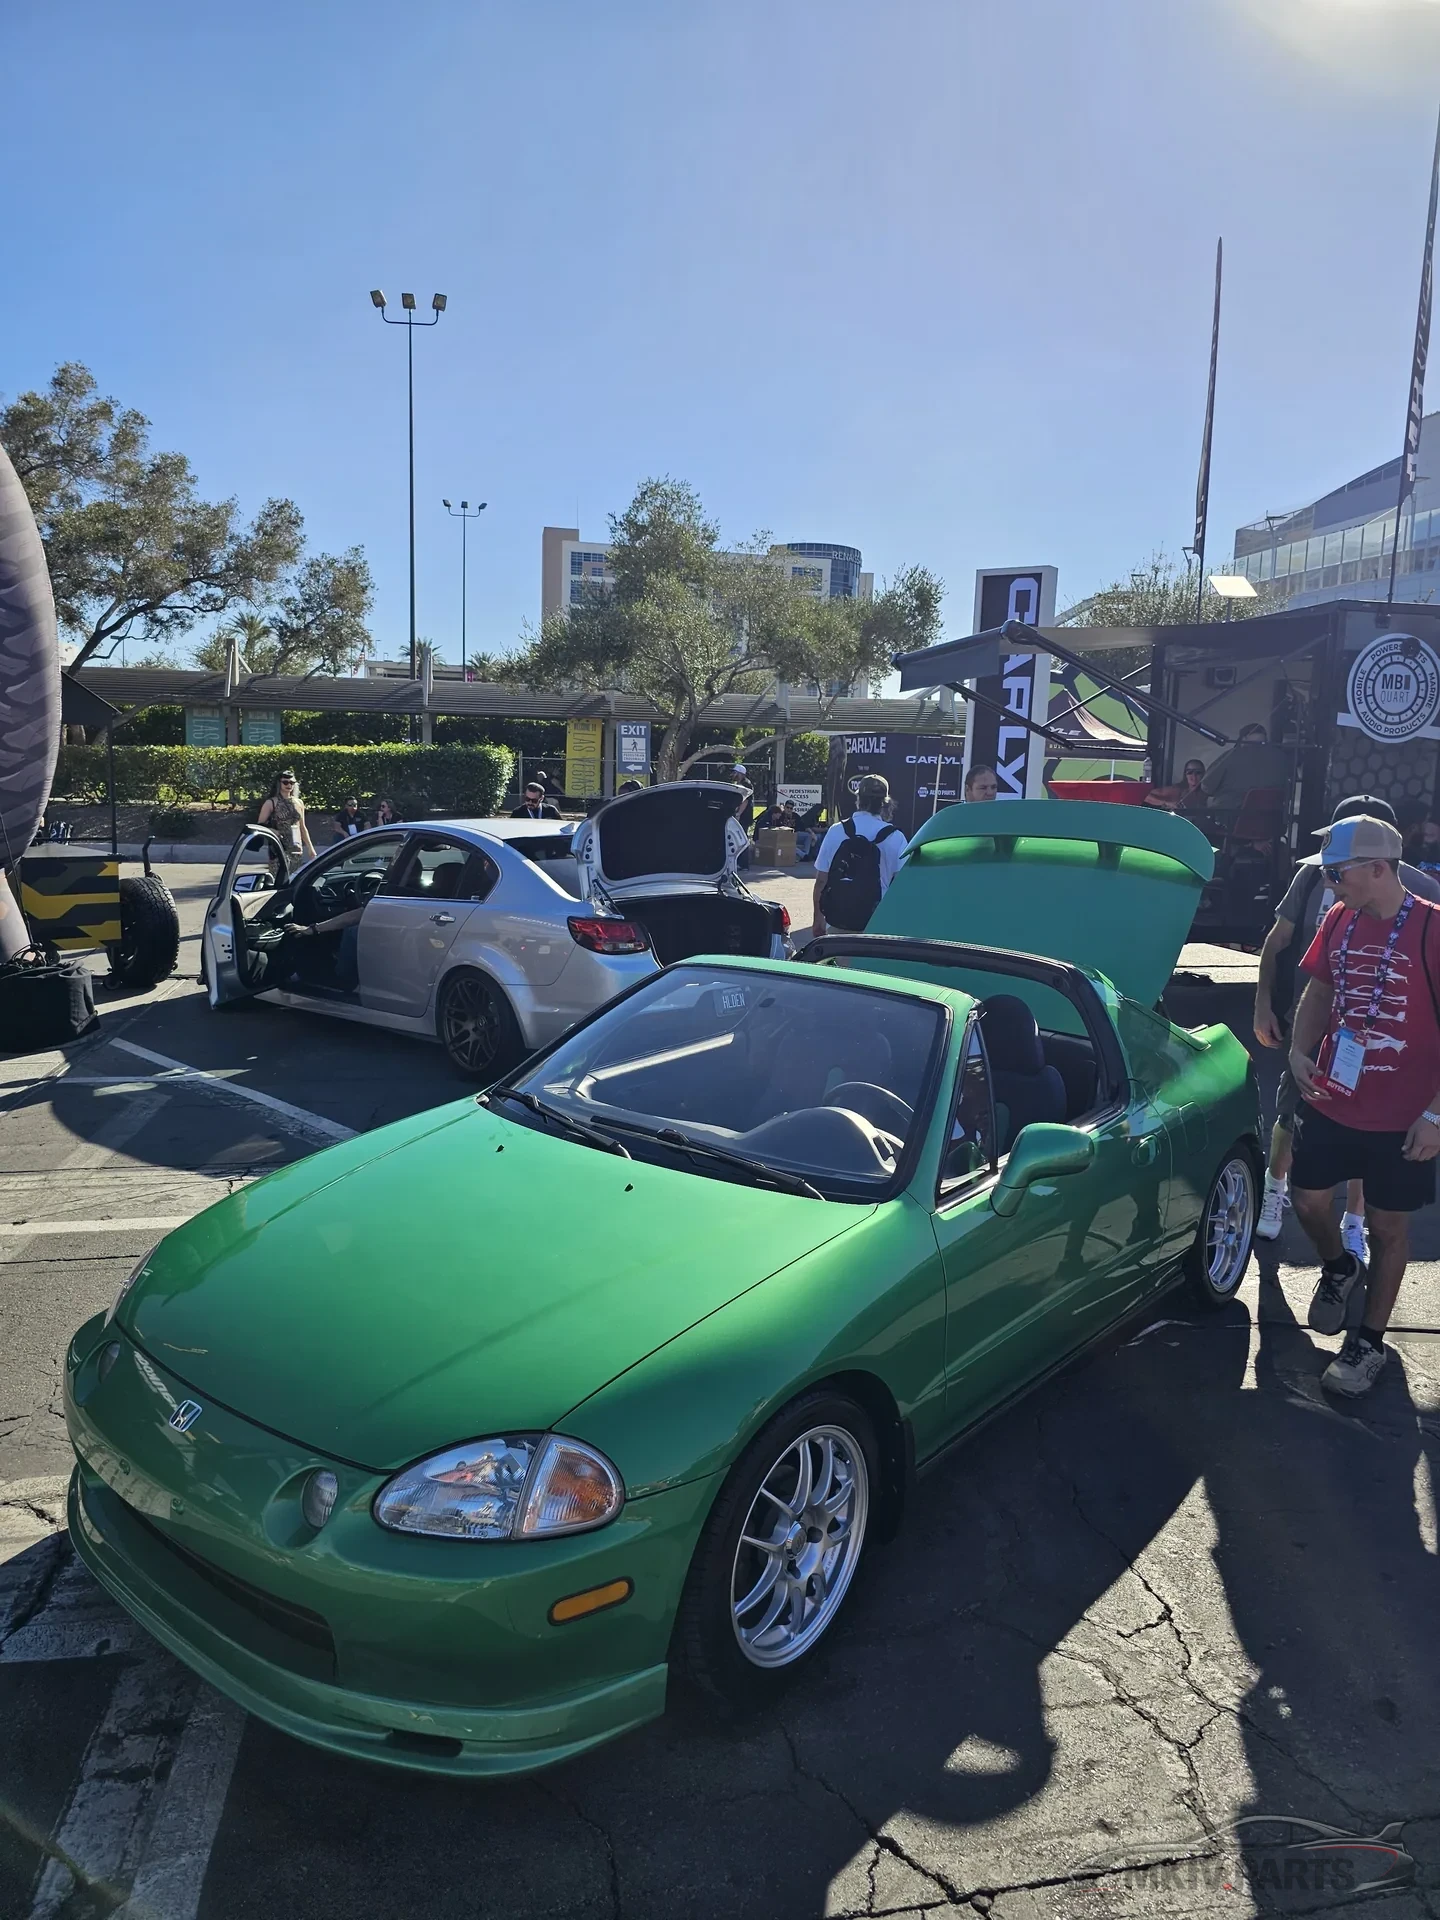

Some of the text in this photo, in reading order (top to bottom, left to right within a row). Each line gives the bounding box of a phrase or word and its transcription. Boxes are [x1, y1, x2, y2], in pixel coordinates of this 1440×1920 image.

[1370, 643, 1428, 664] POWERTS
[1355, 668, 1367, 705] MOBILE
[1380, 690, 1410, 704] QUART
[1425, 672, 1437, 709] MARINE
[620, 725, 647, 736] EXIT
[1360, 710, 1426, 735] AUDIO PRODUCTS
[845, 736, 887, 754] CARLYLE
